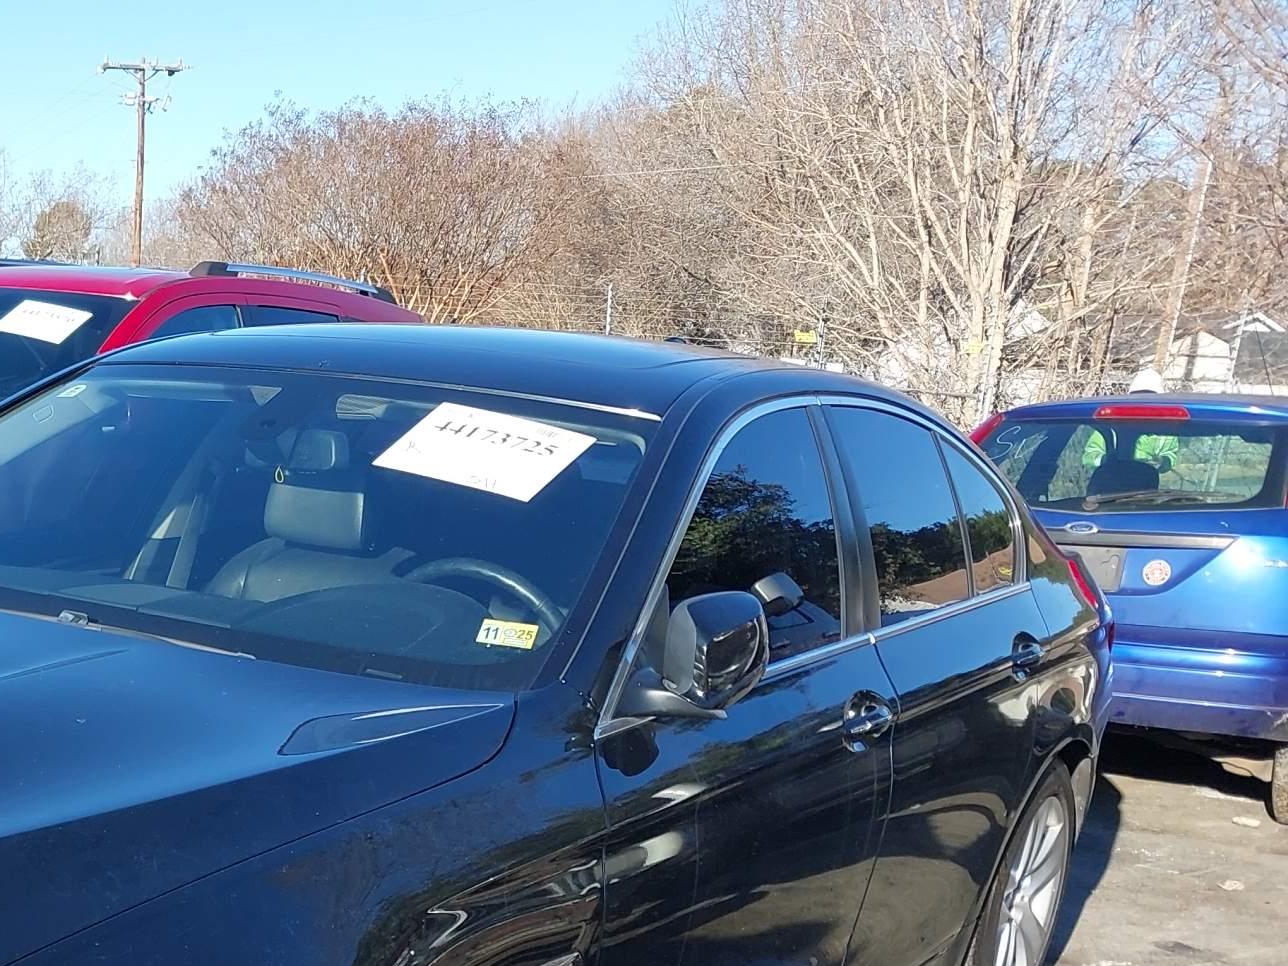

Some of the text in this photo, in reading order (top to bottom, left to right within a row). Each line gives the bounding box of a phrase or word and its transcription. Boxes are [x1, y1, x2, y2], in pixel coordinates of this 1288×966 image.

[433, 420, 560, 457] 44173725
[483, 626, 534, 640] 11 25
